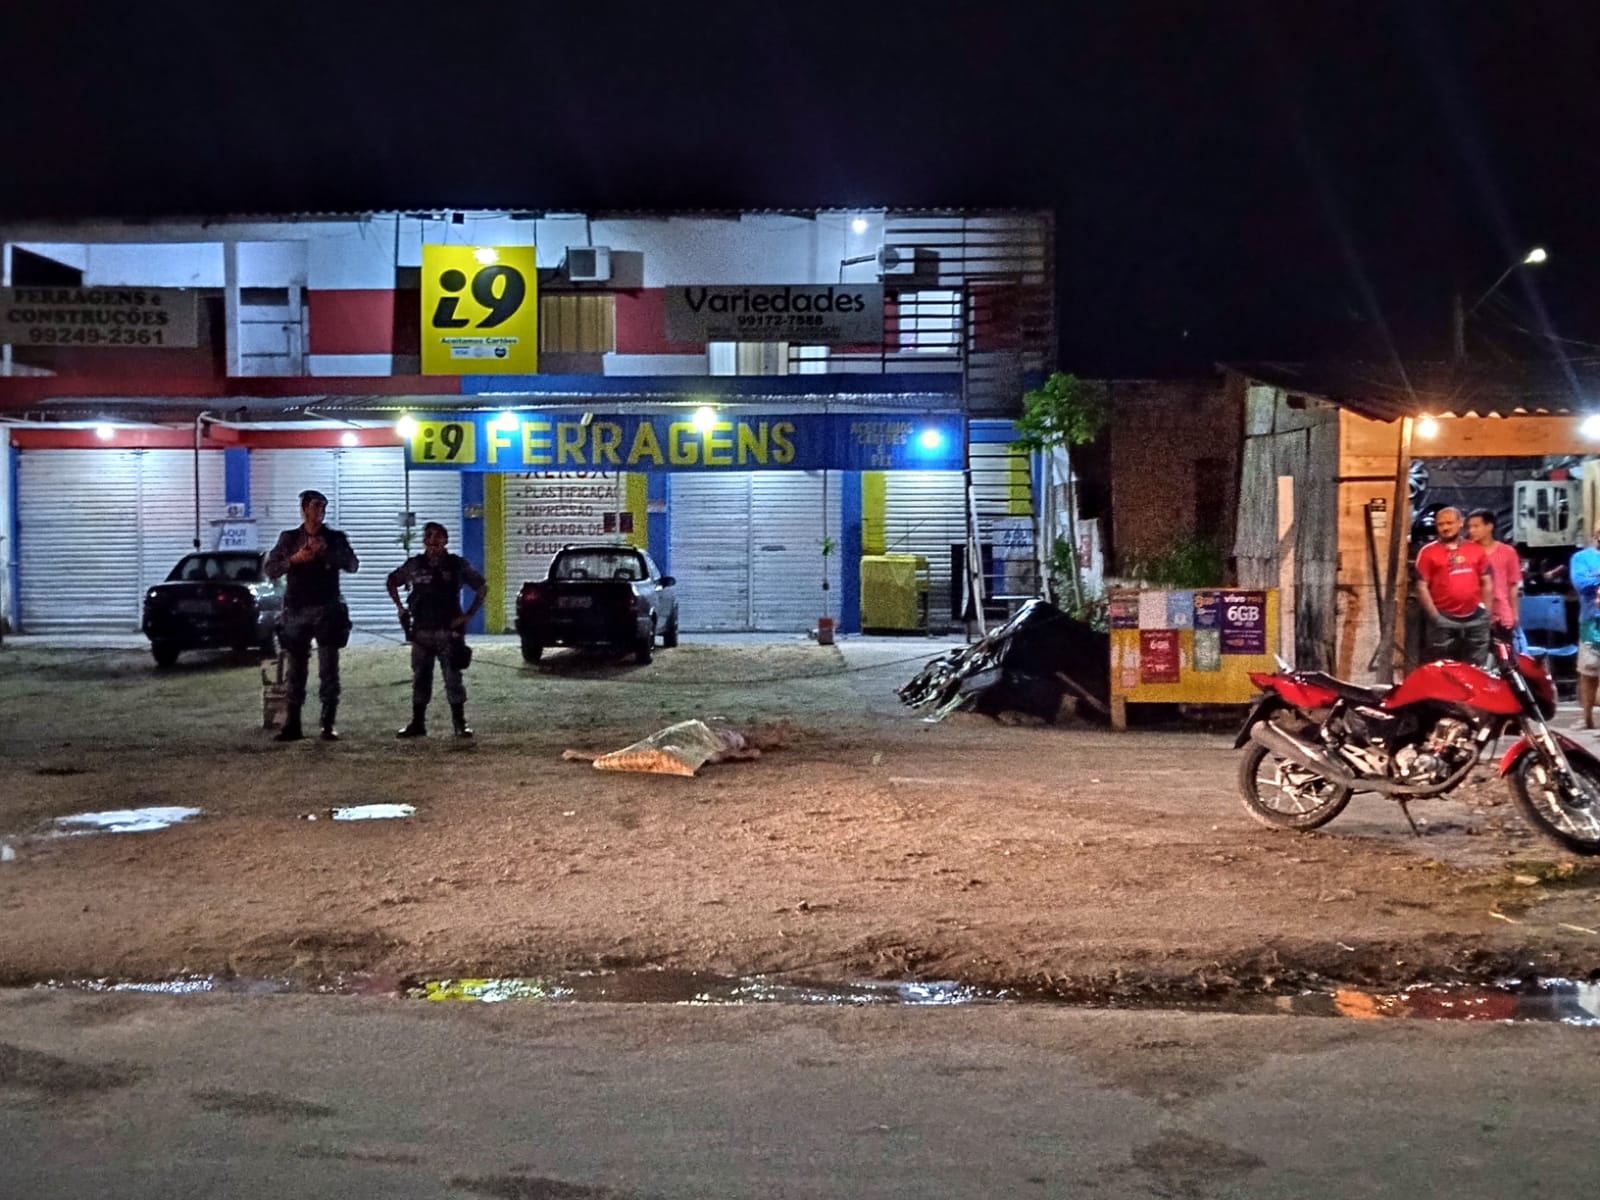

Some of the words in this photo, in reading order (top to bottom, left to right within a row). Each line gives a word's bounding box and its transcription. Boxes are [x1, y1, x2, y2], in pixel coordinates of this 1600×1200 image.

[15, 289, 146, 305] FERRAGENS
[431, 265, 526, 329] i9
[684, 286, 866, 313] Variedades
[28, 327, 164, 345] 99249-2361
[423, 423, 465, 461] i9
[486, 421, 796, 465] FERRAGENS
[1227, 605, 1260, 622] 6GB
